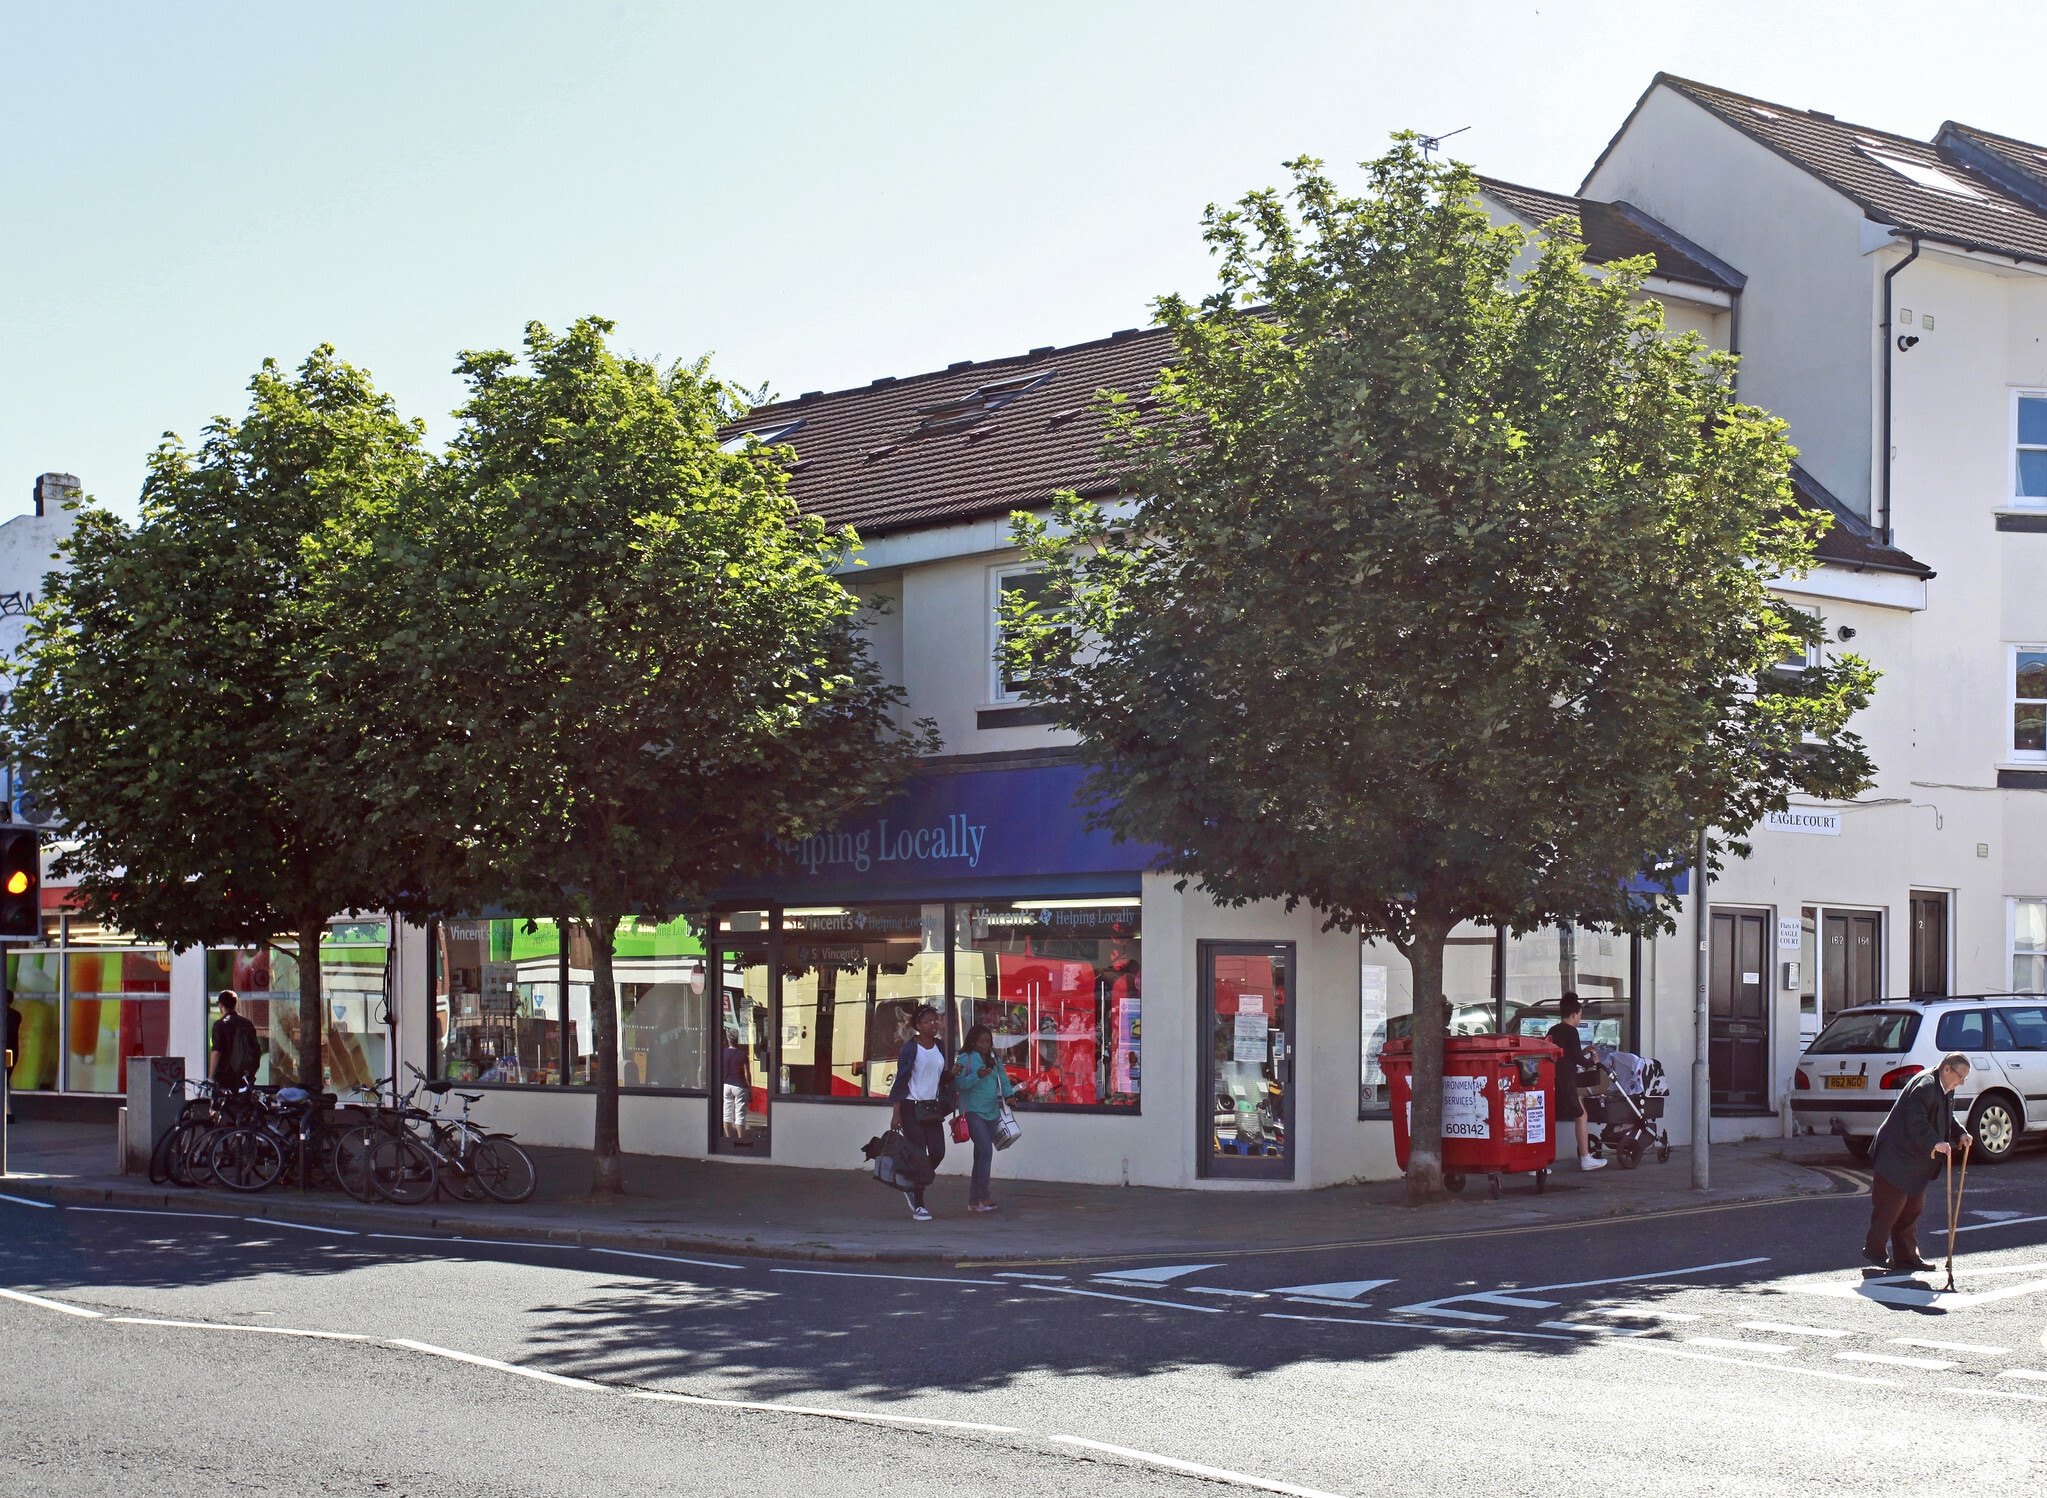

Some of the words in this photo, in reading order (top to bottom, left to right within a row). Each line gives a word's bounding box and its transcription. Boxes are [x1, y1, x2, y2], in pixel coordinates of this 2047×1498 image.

[1770, 813, 1801, 826] EAGLE
[1803, 815, 1836, 829] COURT
[878, 813, 986, 868] Locally
[802, 912, 854, 931] Vincent's
[869, 915, 904, 932] Helping
[975, 908, 1036, 927] Vincent's
[1056, 910, 1096, 928] Helping
[1098, 907, 1135, 925] Locally
[450, 925, 491, 941] Vincent's
[1779, 937, 1798, 945] COURT
[1831, 936, 1844, 946] 162
[1857, 936, 1870, 945] 164
[1830, 1076, 1846, 1088] R62
[1444, 1096, 1473, 1106] SERVICES
[1446, 1123, 1484, 1135] 608142
